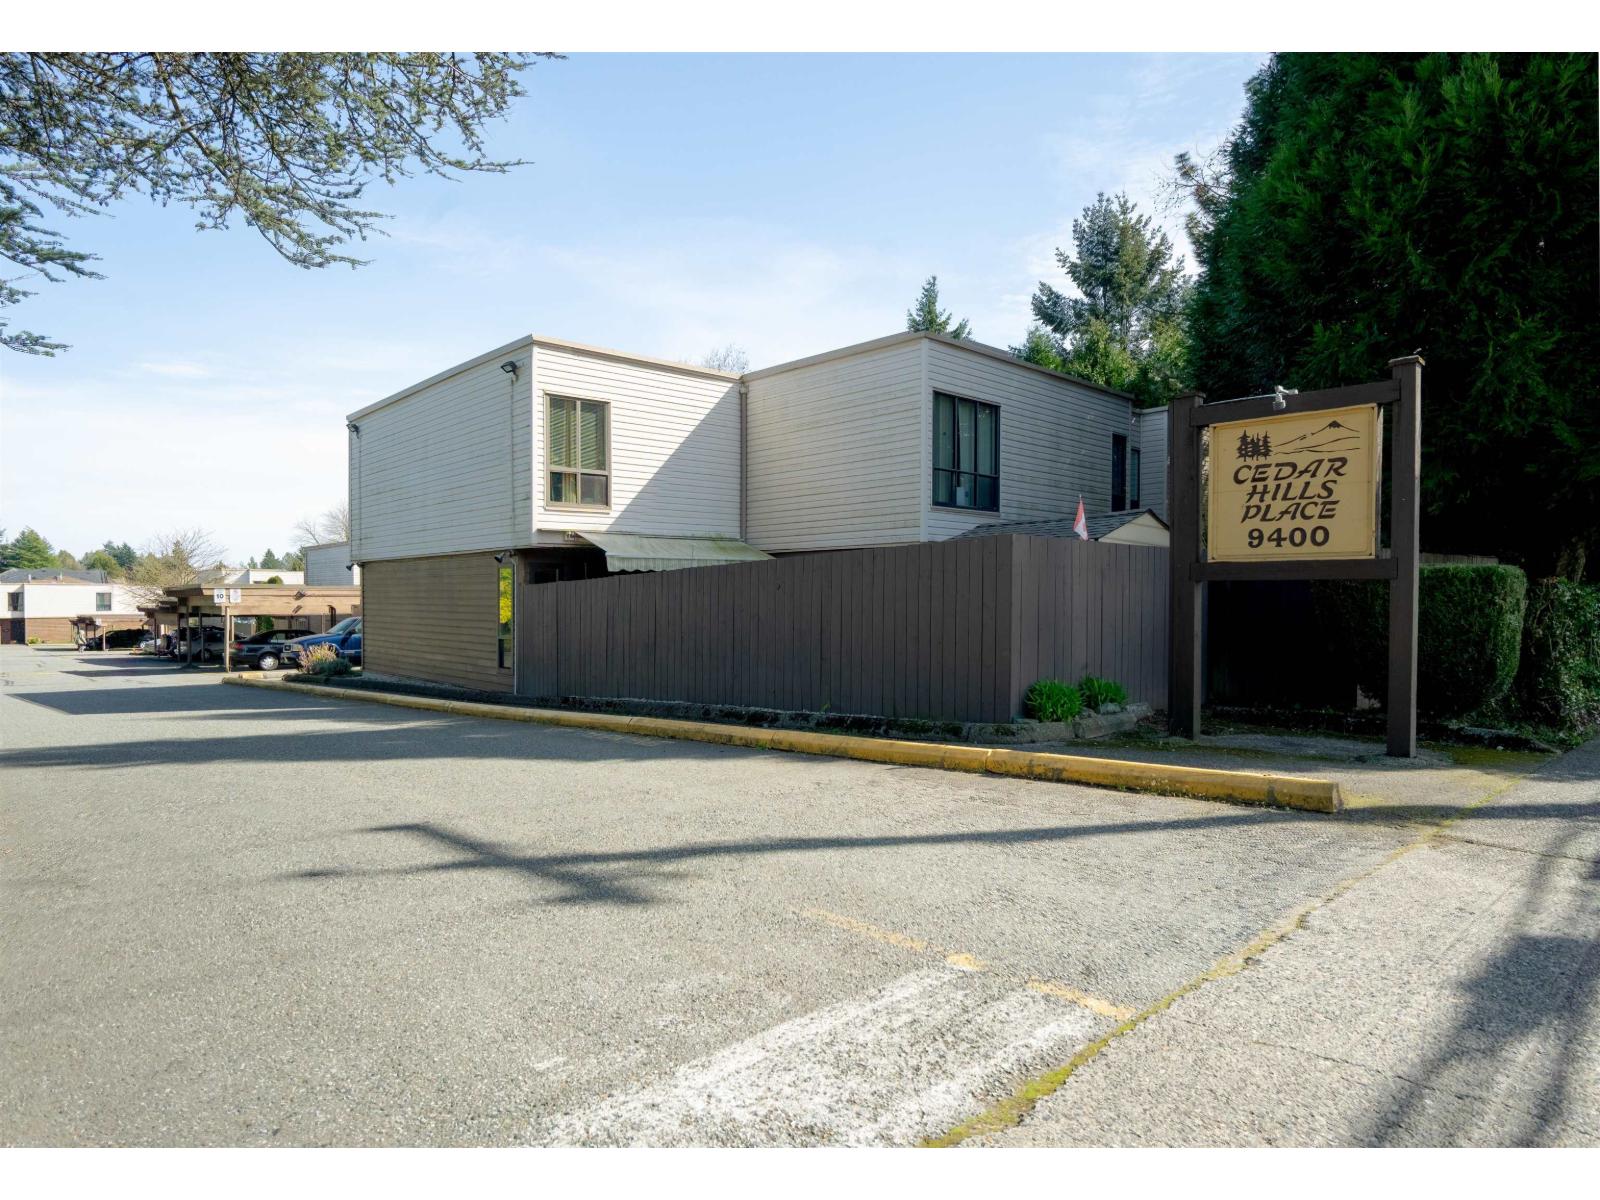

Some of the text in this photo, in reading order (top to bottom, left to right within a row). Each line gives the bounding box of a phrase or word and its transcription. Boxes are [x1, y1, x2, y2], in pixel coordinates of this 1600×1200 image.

[1233, 456, 1348, 485] CEDAR
[1246, 479, 1337, 503] HILLS
[1241, 500, 1340, 523] PLACE
[1248, 525, 1330, 548] 9400
